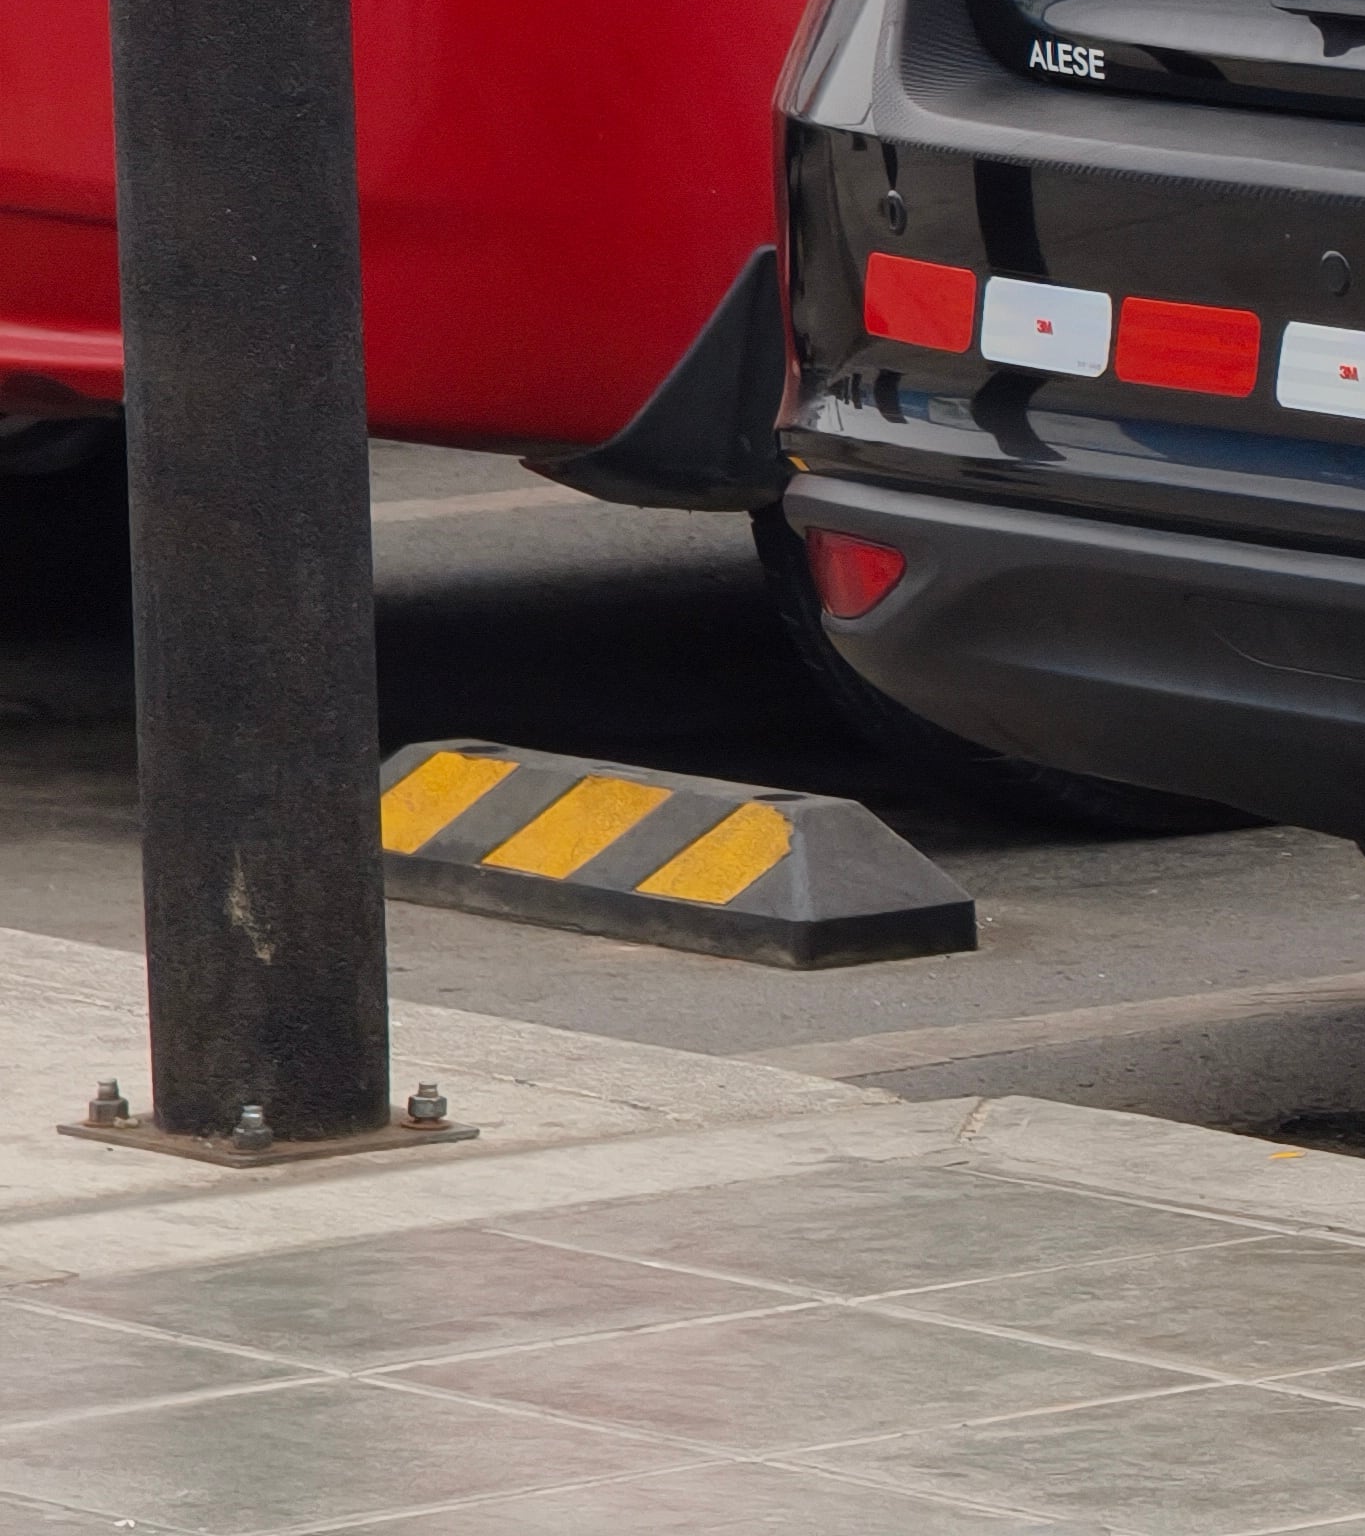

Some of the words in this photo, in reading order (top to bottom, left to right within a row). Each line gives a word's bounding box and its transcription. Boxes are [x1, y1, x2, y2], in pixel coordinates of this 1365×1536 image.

[1029, 39, 1106, 81] ALESE
[1036, 319, 1054, 336] 3M
[1338, 364, 1359, 382] 3M
